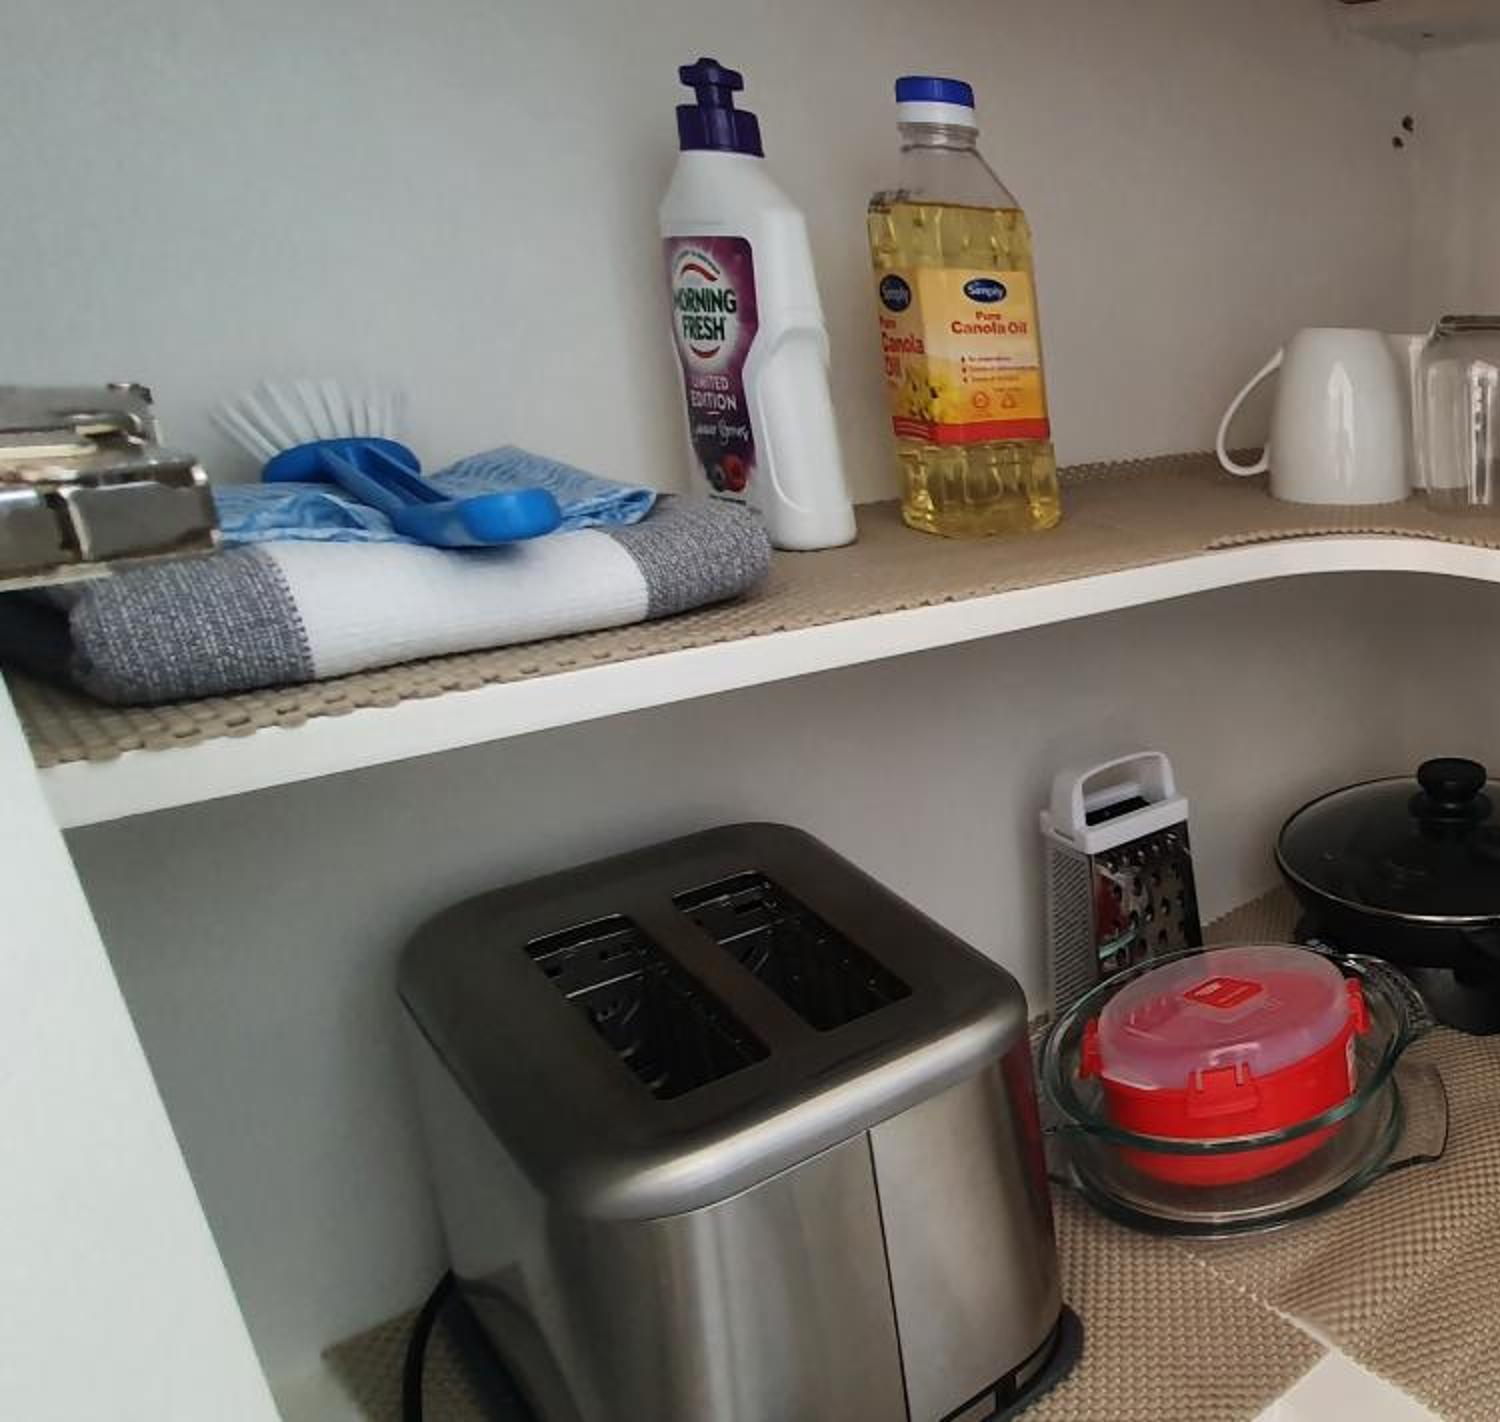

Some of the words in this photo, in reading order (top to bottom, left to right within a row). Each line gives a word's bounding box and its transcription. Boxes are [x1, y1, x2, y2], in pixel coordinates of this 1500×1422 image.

[967, 281, 1005, 299] Simply
[976, 311, 1003, 321] Pure
[682, 314, 727, 341] FRESH
[952, 321, 1006, 334] Canola
[1008, 321, 1027, 334] Oil
[690, 390, 737, 411] EDITION
